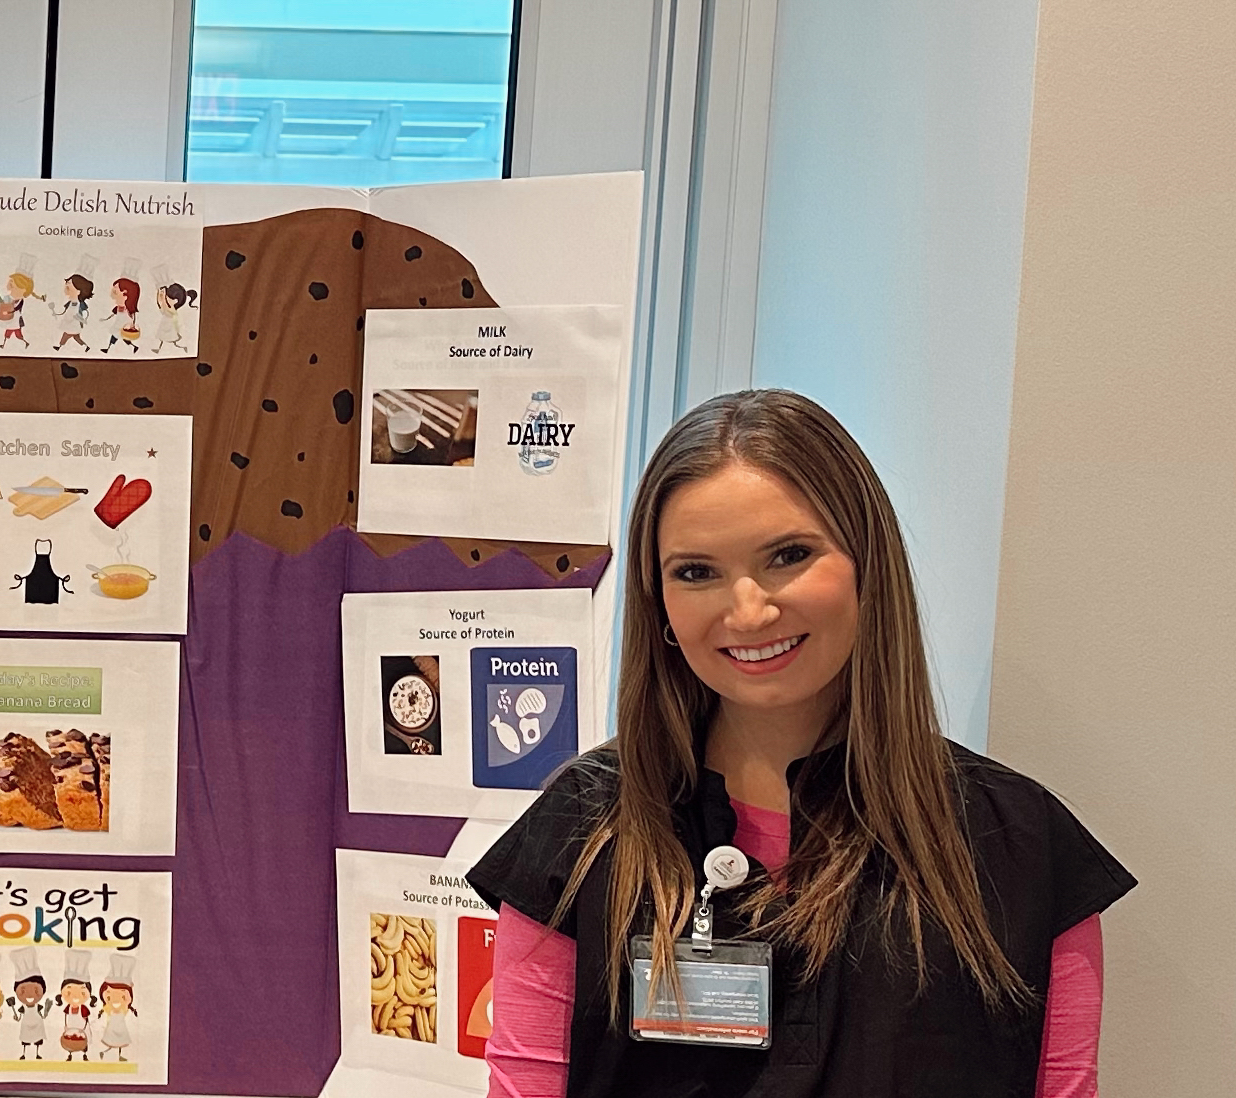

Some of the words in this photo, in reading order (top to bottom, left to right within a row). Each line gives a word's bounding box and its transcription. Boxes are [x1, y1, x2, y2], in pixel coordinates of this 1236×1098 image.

[43, 187, 109, 214] Delish
[115, 191, 196, 217] Nutrish
[37, 224, 84, 239] Cooking
[86, 226, 115, 239] Class
[478, 326, 507, 338] MILK
[449, 345, 486, 358] Source
[489, 345, 502, 357] of
[504, 345, 534, 360] Dairy
[507, 422, 575, 446] DAIRY
[61, 440, 121, 462] Safety
[449, 608, 485, 622] Yogurt
[419, 628, 457, 640] Source
[460, 627, 472, 640] of
[475, 627, 515, 640] Protein
[490, 657, 560, 677] Protein
[47, 695, 92, 709] Bread
[429, 874, 473, 890] BANAN
[44, 883, 118, 913] get
[403, 890, 439, 905] Source
[441, 895, 453, 906] of
